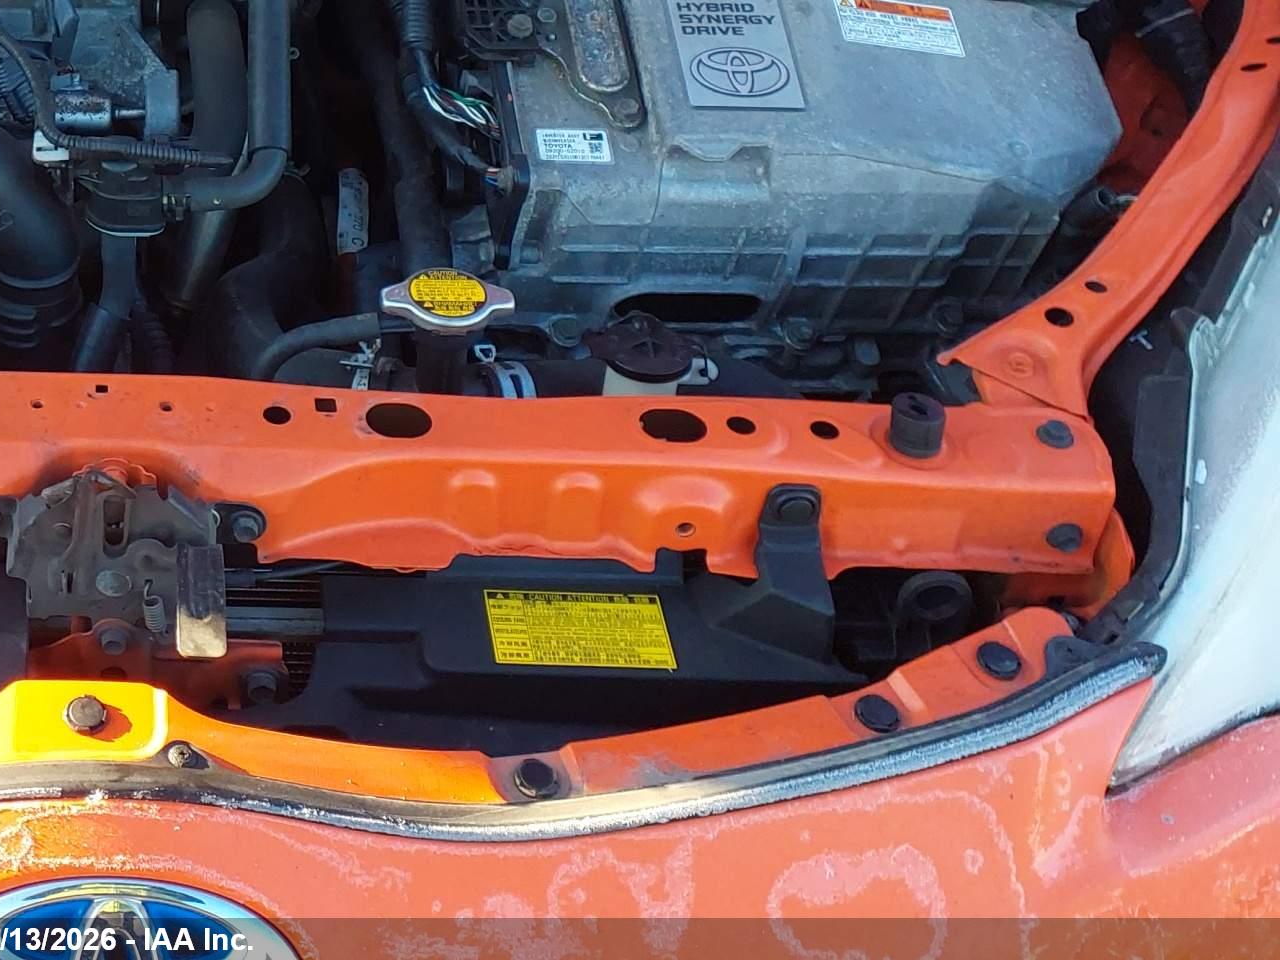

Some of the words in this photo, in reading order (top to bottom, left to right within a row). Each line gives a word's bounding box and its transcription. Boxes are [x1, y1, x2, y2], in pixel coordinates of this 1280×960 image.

[676, 2, 755, 13] HYBRID
[678, 14, 776, 25] SYNERGY
[681, 25, 745, 36] DRIVE
[529, 592, 562, 601] CAUTION
[567, 594, 609, 603] ATTENTION
